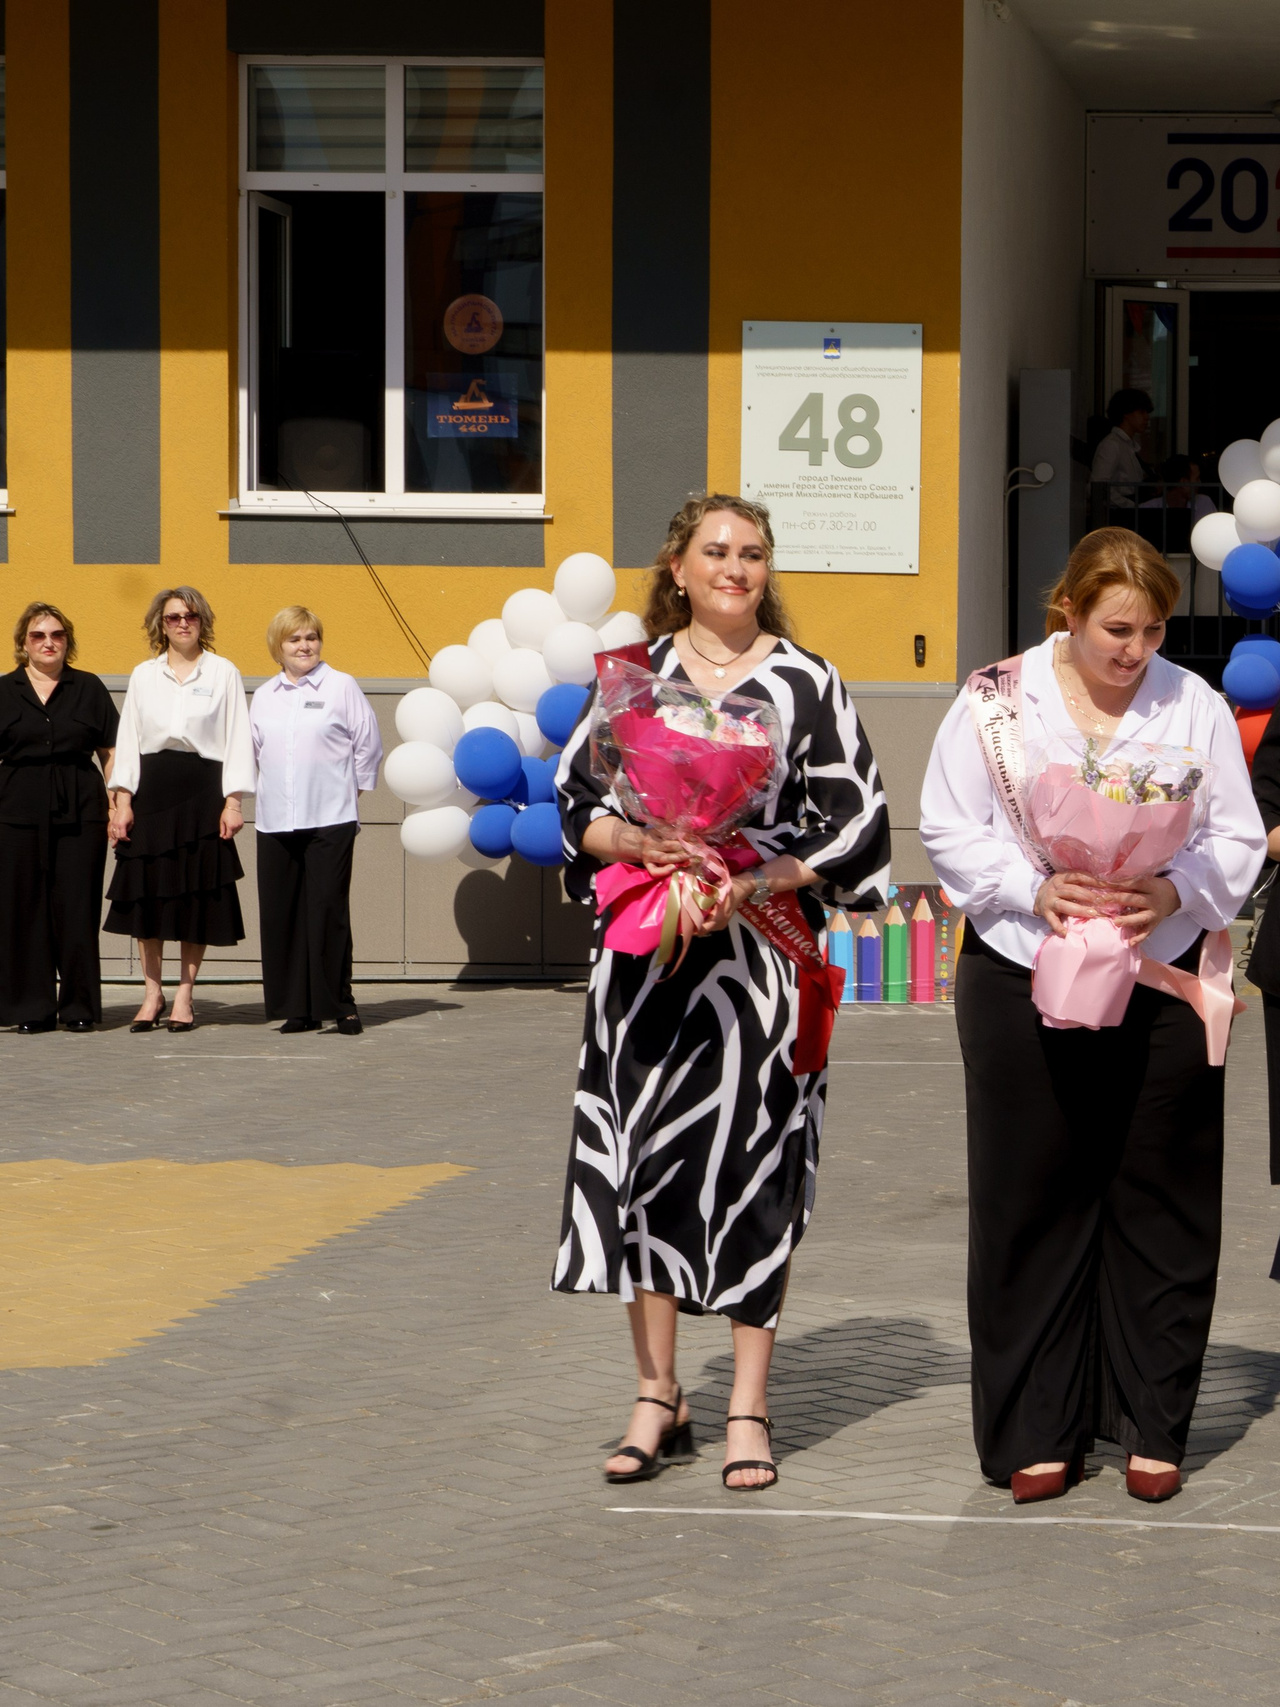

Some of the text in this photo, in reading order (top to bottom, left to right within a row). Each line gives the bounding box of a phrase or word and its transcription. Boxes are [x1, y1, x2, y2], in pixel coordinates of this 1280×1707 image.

[436, 414, 510, 424] ТЮМЕНЬ
[458, 424, 488, 433] 440
[778, 392, 883, 468] 48
[798, 475, 828, 484] города
[792, 482, 816, 490] Героя
[818, 483, 868, 492] Советского
[757, 490, 904, 501] Дмитрия Михайловича Карбышева
[782, 520, 877, 532] пн-сб 7.30-21.00
[980, 686, 996, 703] 48
[984, 710, 1016, 794] Классный
